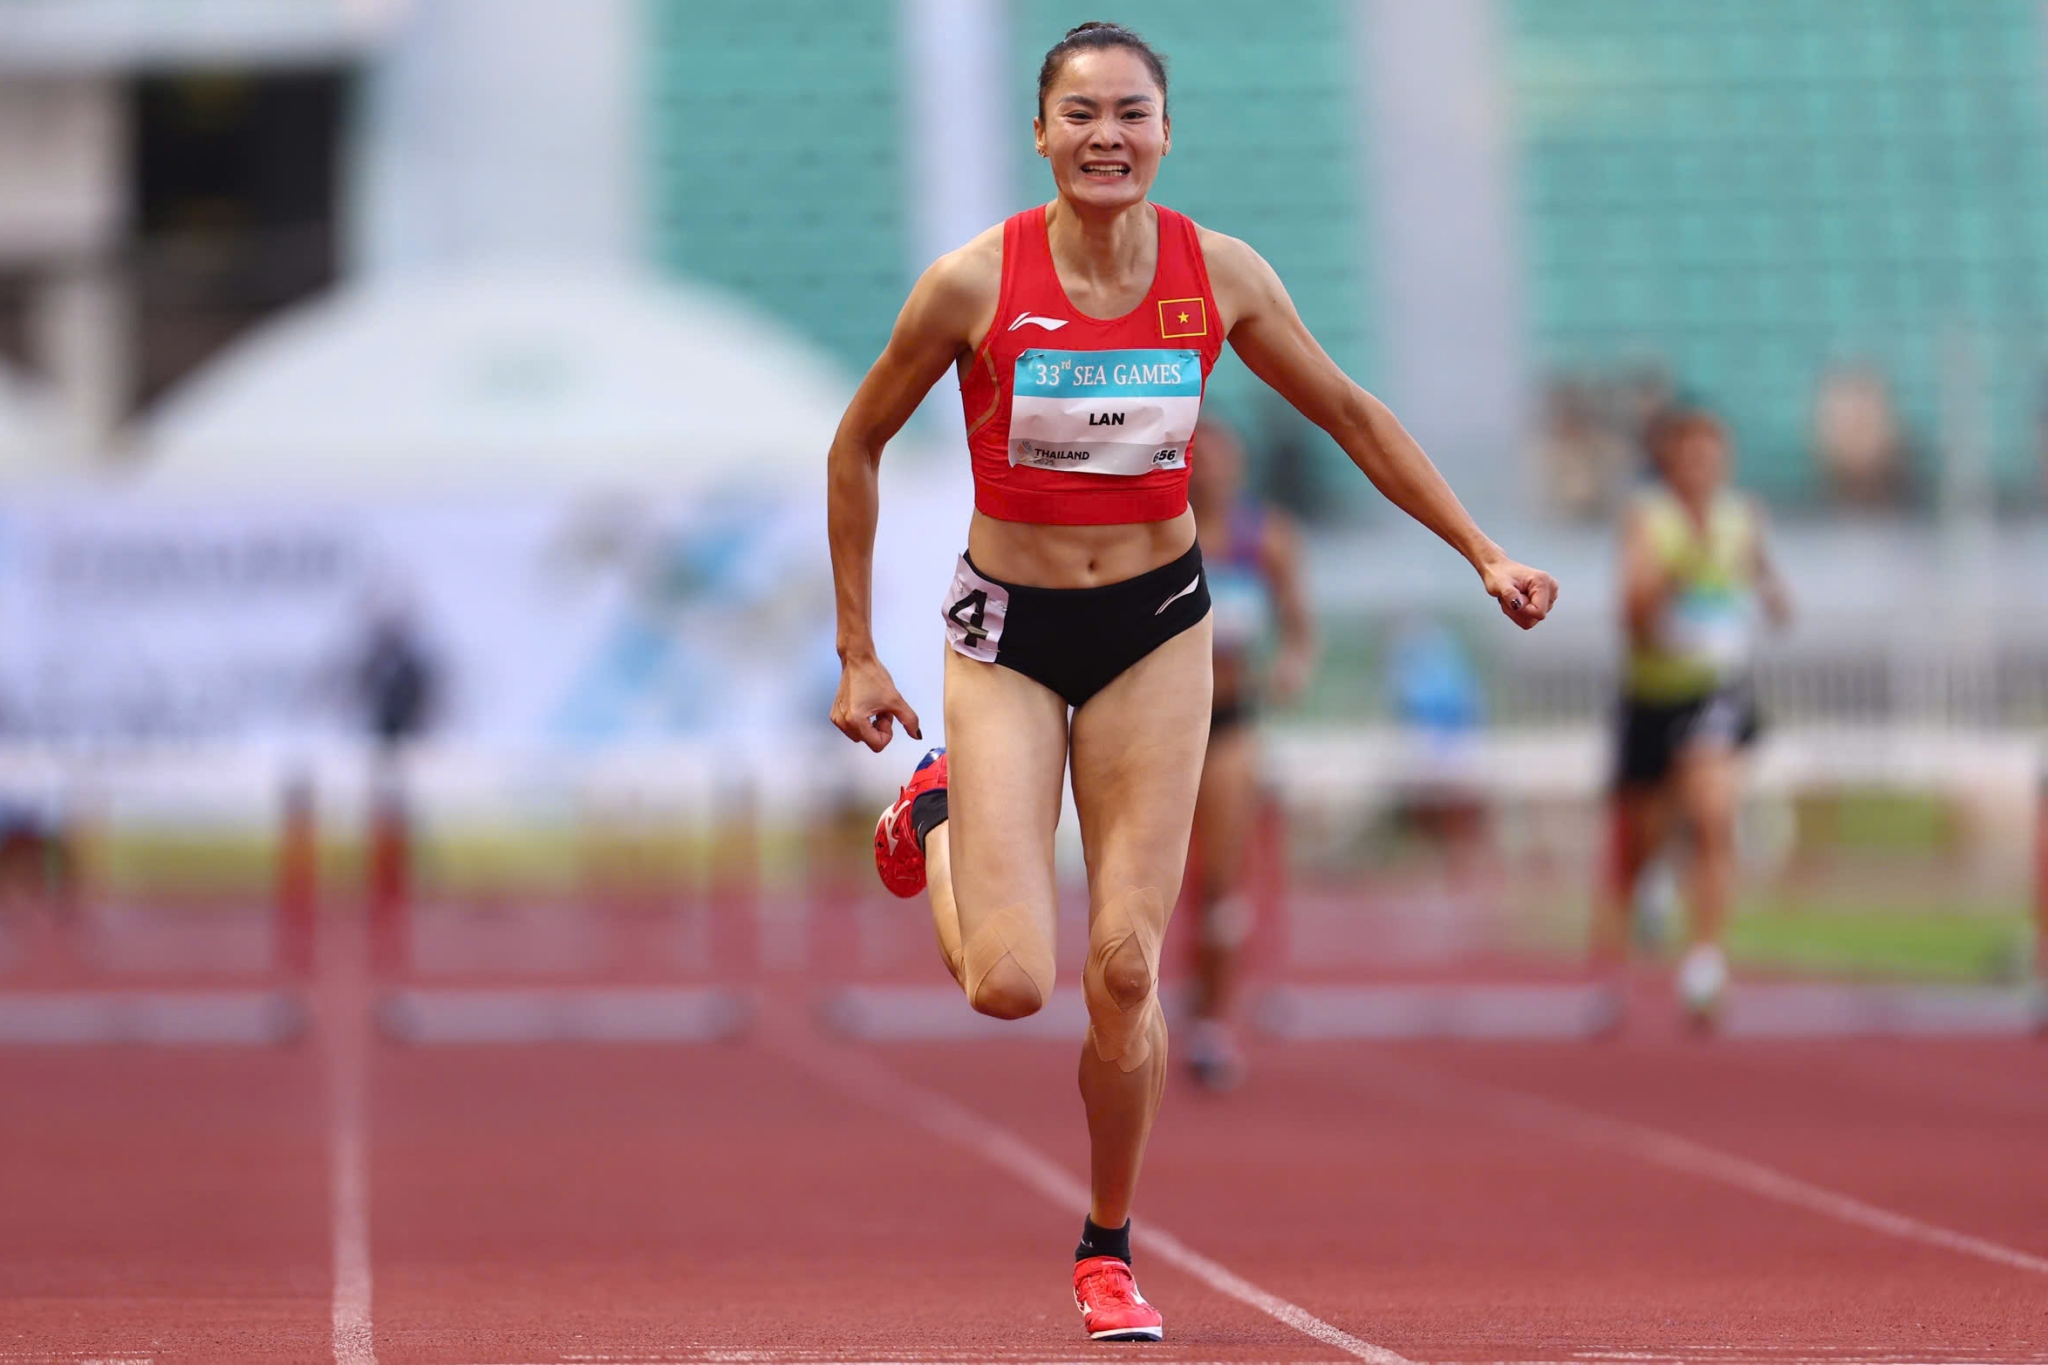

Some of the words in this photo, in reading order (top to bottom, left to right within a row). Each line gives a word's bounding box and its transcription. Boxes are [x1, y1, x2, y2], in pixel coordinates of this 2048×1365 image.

[1036, 360, 1071, 386] 33rd
[1073, 365, 1107, 385] SEA
[1114, 363, 1182, 385] GAMES
[1089, 412, 1125, 426] LAN
[1035, 448, 1090, 461] THAILAND
[949, 588, 990, 648] 4
